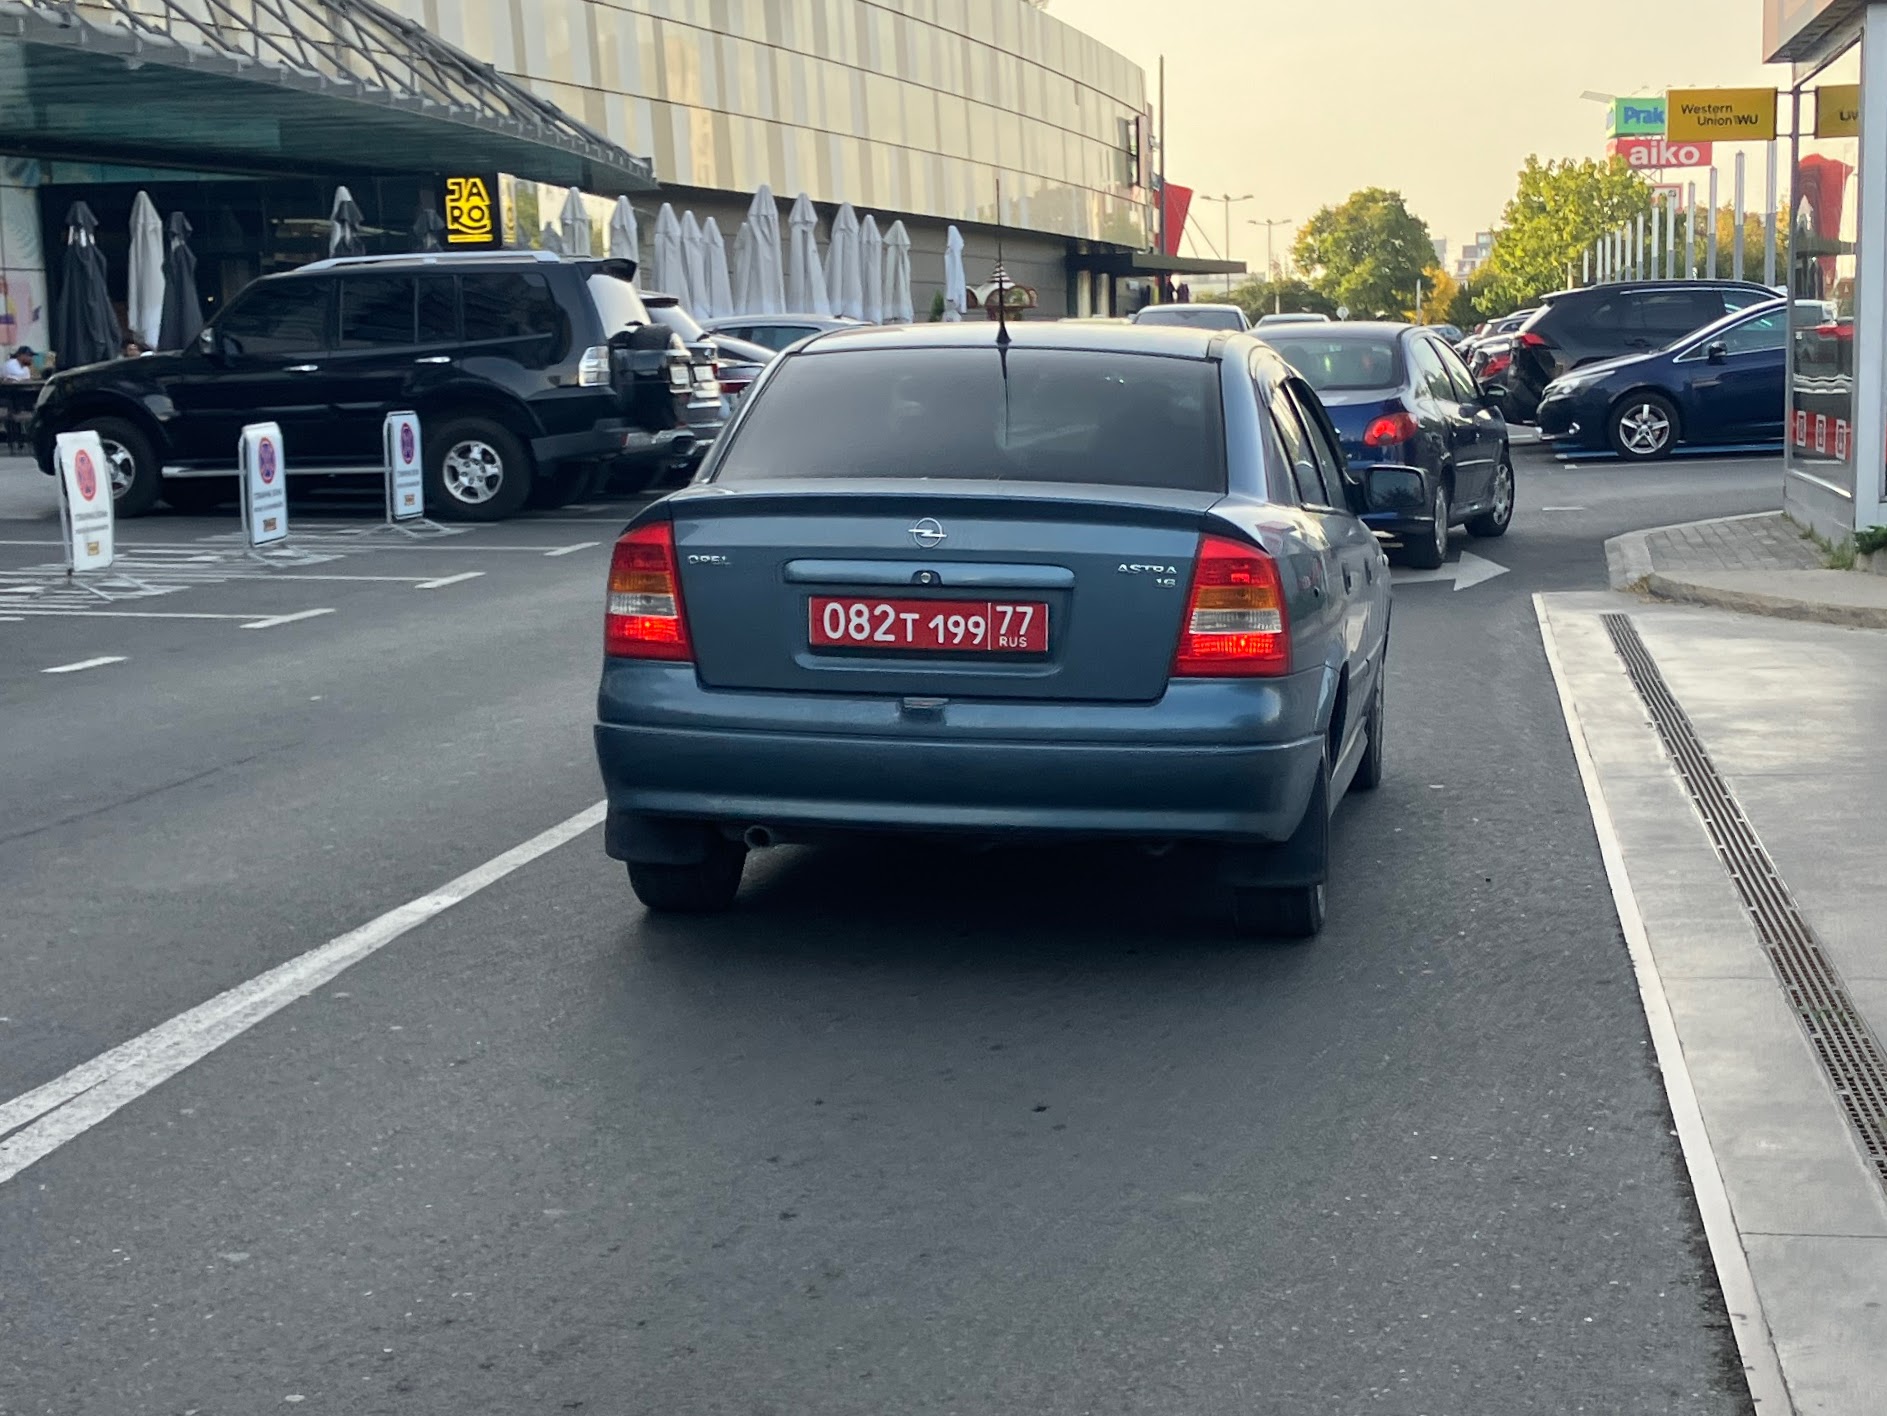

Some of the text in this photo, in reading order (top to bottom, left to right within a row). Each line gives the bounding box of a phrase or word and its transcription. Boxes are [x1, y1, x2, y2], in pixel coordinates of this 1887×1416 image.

[1681, 104, 1733, 115] Western
[1697, 115, 1733, 126] Union
[1629, 141, 1700, 165] aiko
[1117, 563, 1178, 574] ASTRA
[928, 614, 986, 645] 199
[995, 605, 1034, 636] 77
[999, 636, 1028, 648] RUS
